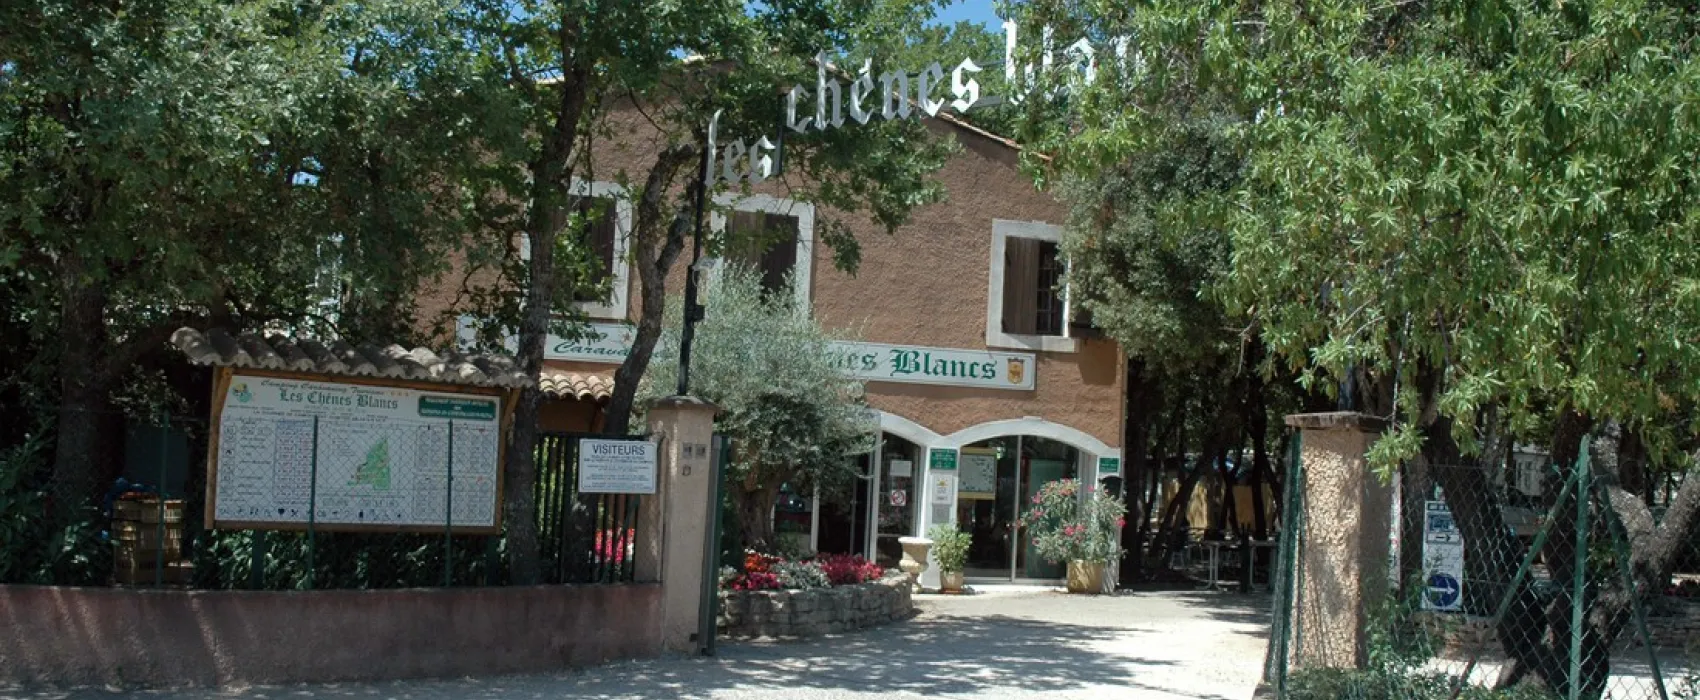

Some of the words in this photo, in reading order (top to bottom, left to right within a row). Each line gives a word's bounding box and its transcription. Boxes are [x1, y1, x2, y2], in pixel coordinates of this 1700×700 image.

[704, 107, 776, 188] les
[553, 341, 633, 357] Carava
[890, 349, 998, 380] Blancs
[280, 387, 303, 401] Les
[356, 393, 398, 409] Blancs
[592, 443, 645, 455] VISITEURS
